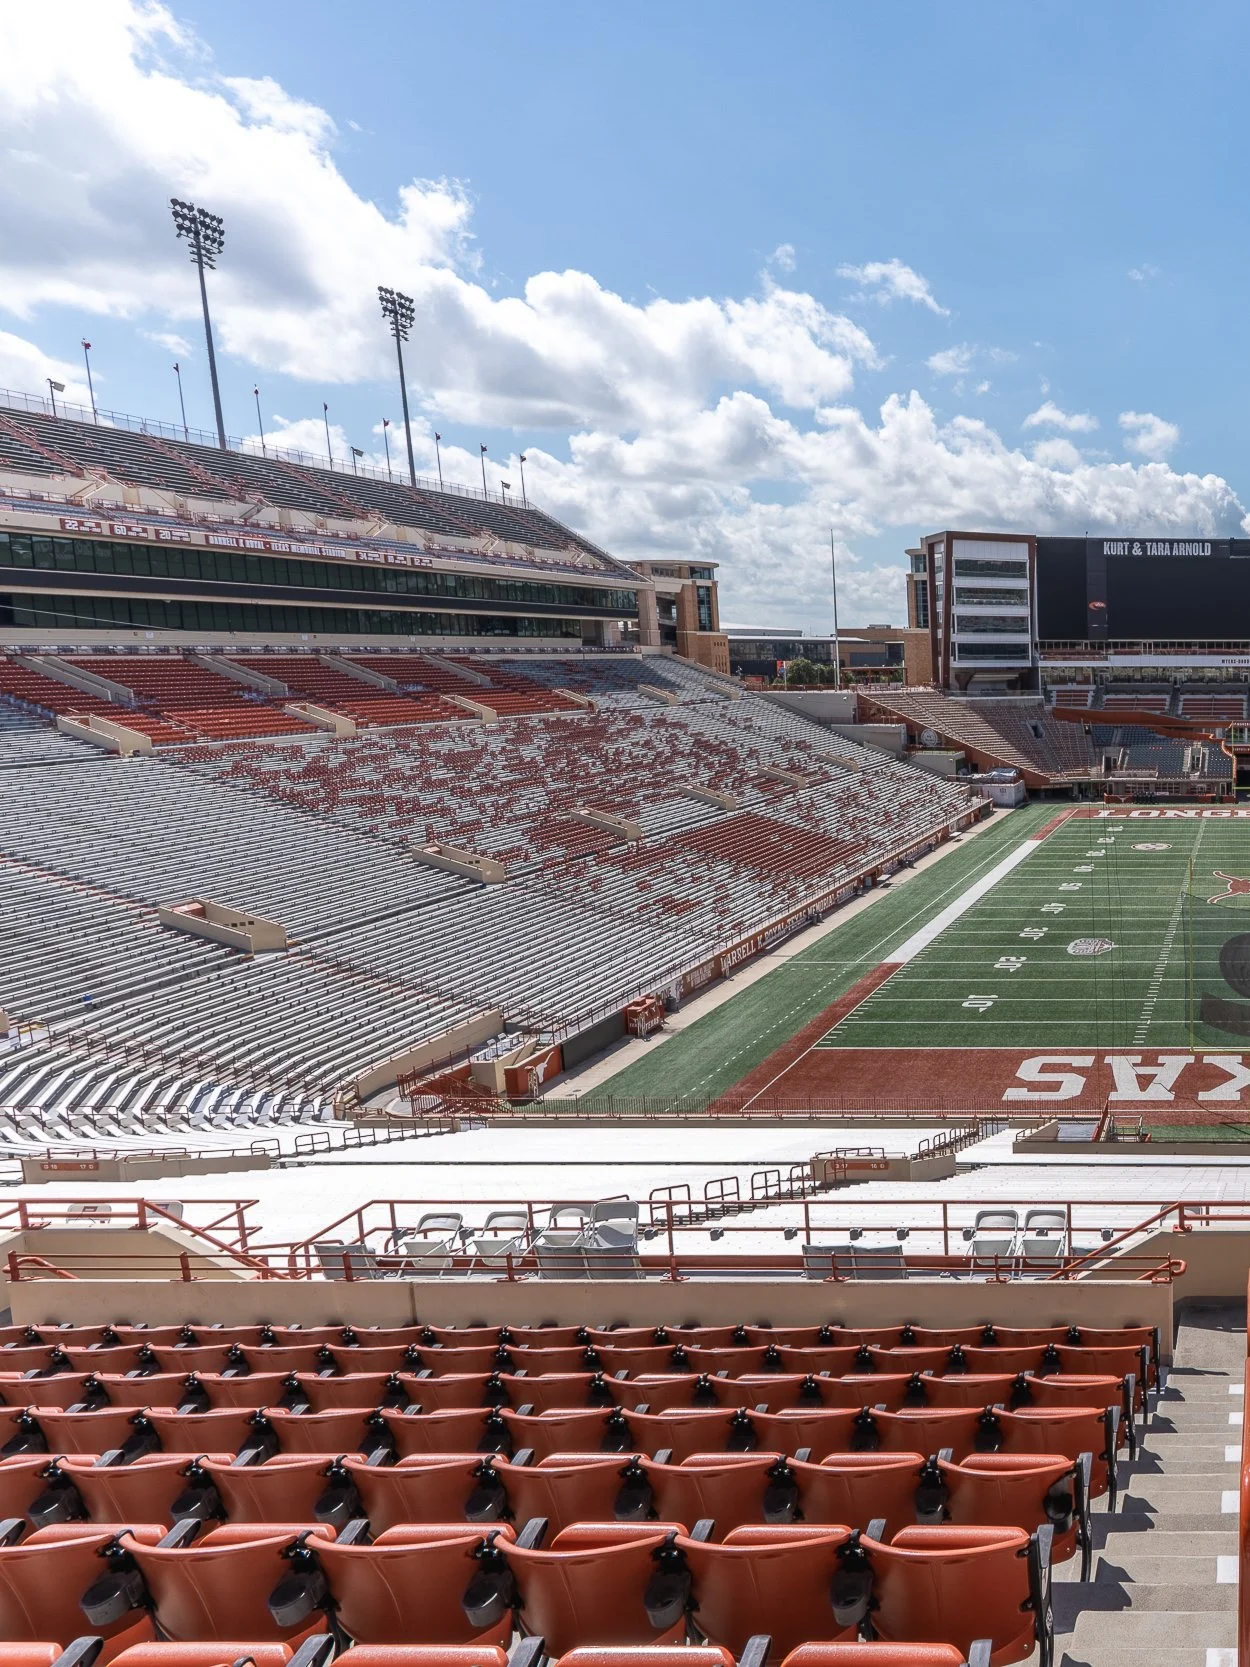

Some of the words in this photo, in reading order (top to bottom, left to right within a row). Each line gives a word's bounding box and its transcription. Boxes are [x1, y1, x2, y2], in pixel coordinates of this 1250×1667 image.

[64, 519, 79, 531] 22
[113, 525, 127, 536] 60
[159, 530, 171, 540] 20
[271, 543, 290, 552] TEXAS
[322, 547, 346, 558] STADIUM
[1103, 541, 1130, 555] KURT
[1132, 541, 1143, 555] &
[1146, 542, 1171, 556] TARA
[1172, 542, 1212, 556] ARNOLD
[1018, 927, 1049, 938] 30
[993, 956, 1028, 969] 20
[961, 994, 999, 1008] 10
